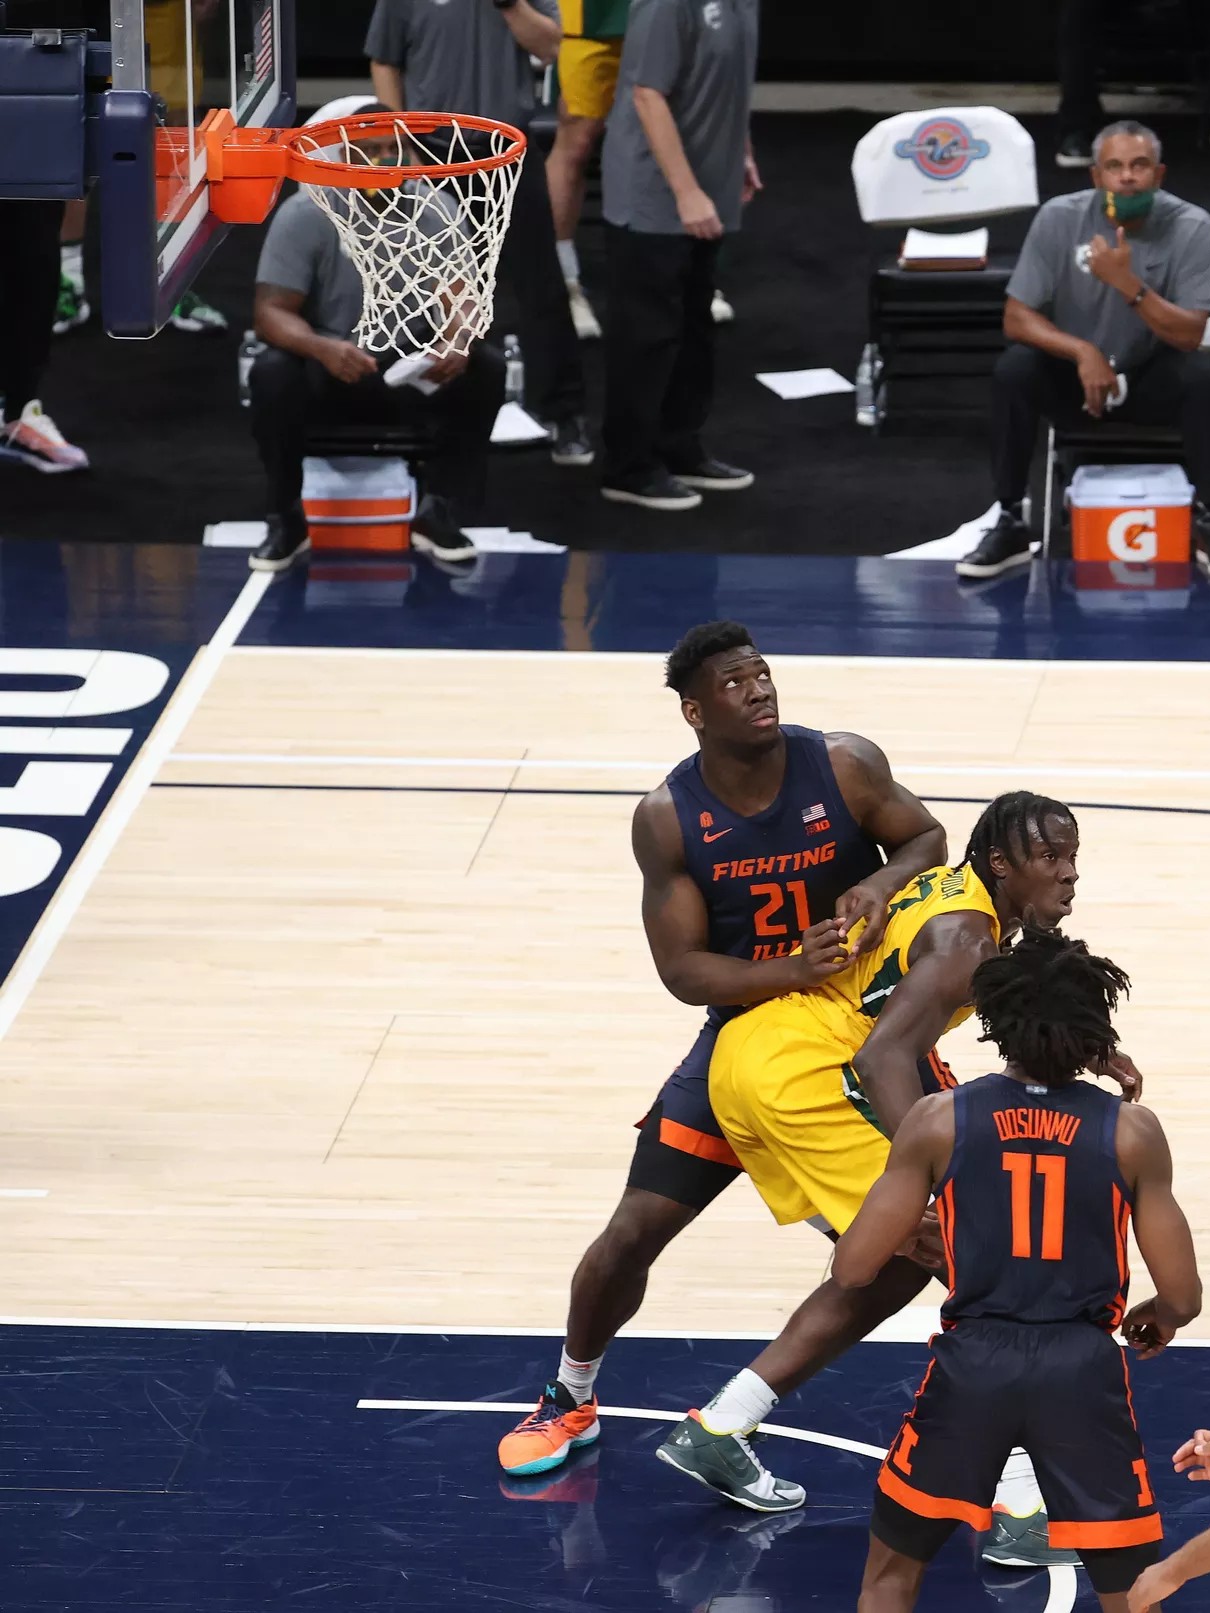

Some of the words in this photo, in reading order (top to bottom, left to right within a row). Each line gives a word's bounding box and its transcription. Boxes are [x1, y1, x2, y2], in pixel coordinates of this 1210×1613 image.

[1107, 508, 1157, 563] G
[712, 841, 837, 882] FIGHTING
[750, 880, 811, 936] 21
[992, 1108, 1083, 1146] DOSUNMU
[1002, 1152, 1066, 1260] 11
